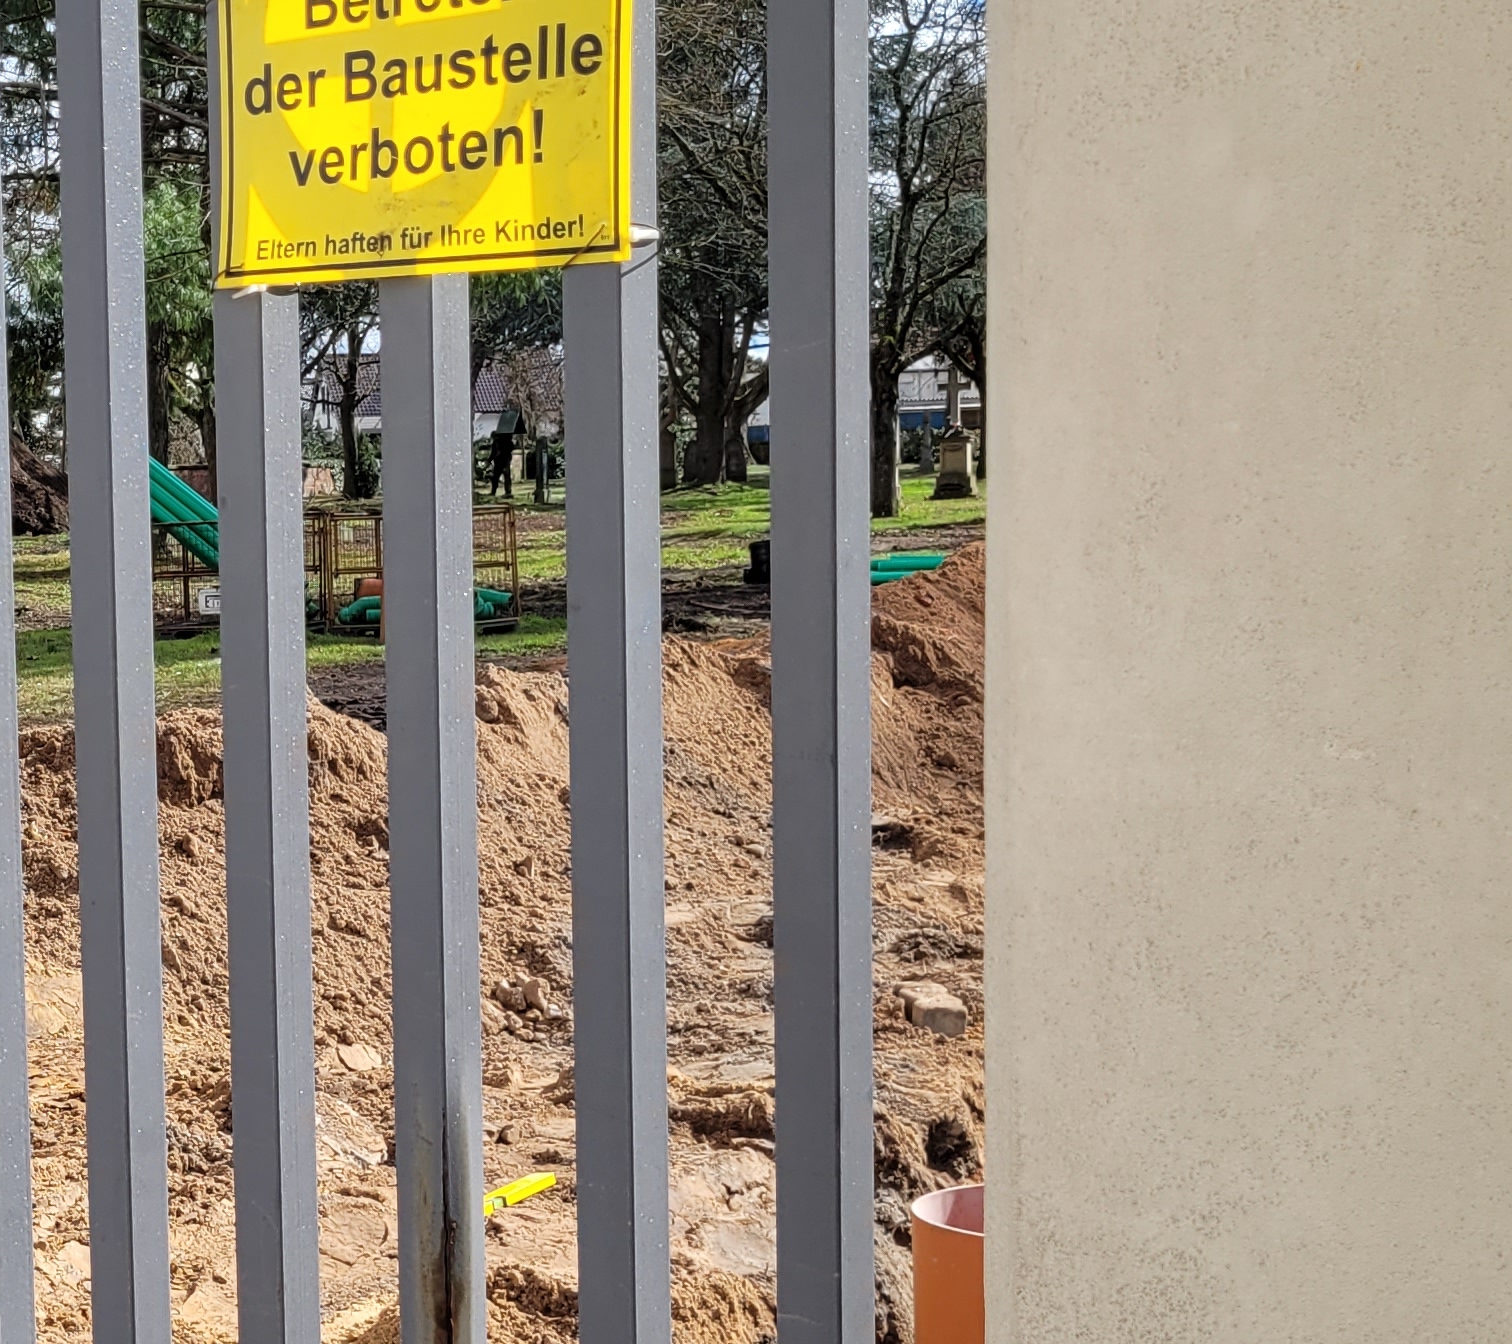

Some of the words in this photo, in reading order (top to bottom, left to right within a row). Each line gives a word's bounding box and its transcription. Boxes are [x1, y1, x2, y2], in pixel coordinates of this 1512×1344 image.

[243, 63, 326, 116] der
[343, 22, 603, 102] Baustelle
[288, 109, 544, 187] verboten!
[255, 236, 317, 261] Eltern
[324, 231, 392, 254] haften
[399, 227, 433, 250] für
[440, 225, 486, 248] Ihre
[495, 213, 584, 240] Kinder!
